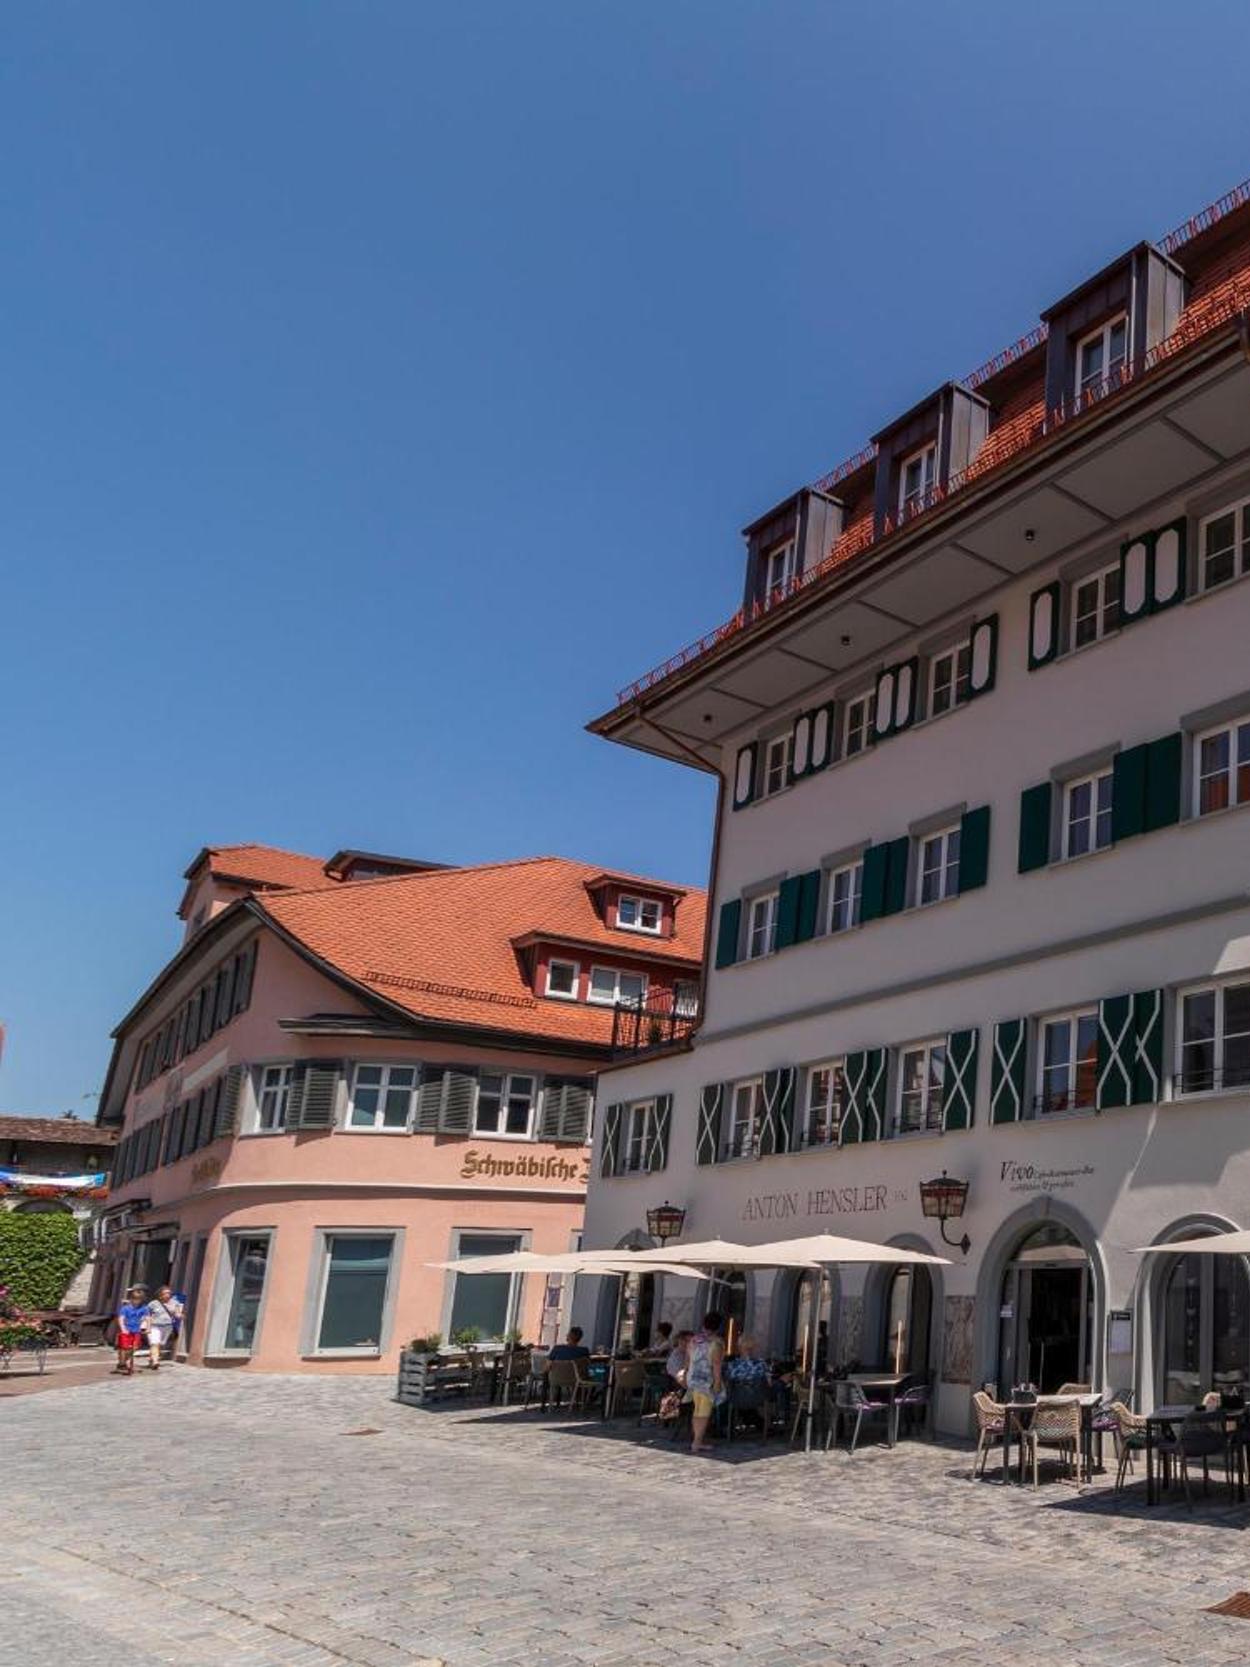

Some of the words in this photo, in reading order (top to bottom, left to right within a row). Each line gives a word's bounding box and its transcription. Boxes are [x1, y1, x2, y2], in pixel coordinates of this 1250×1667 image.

[1000, 1161, 1035, 1182] Vivo
[742, 1192, 800, 1222] ANTON
[807, 1184, 888, 1217] HENSLER
